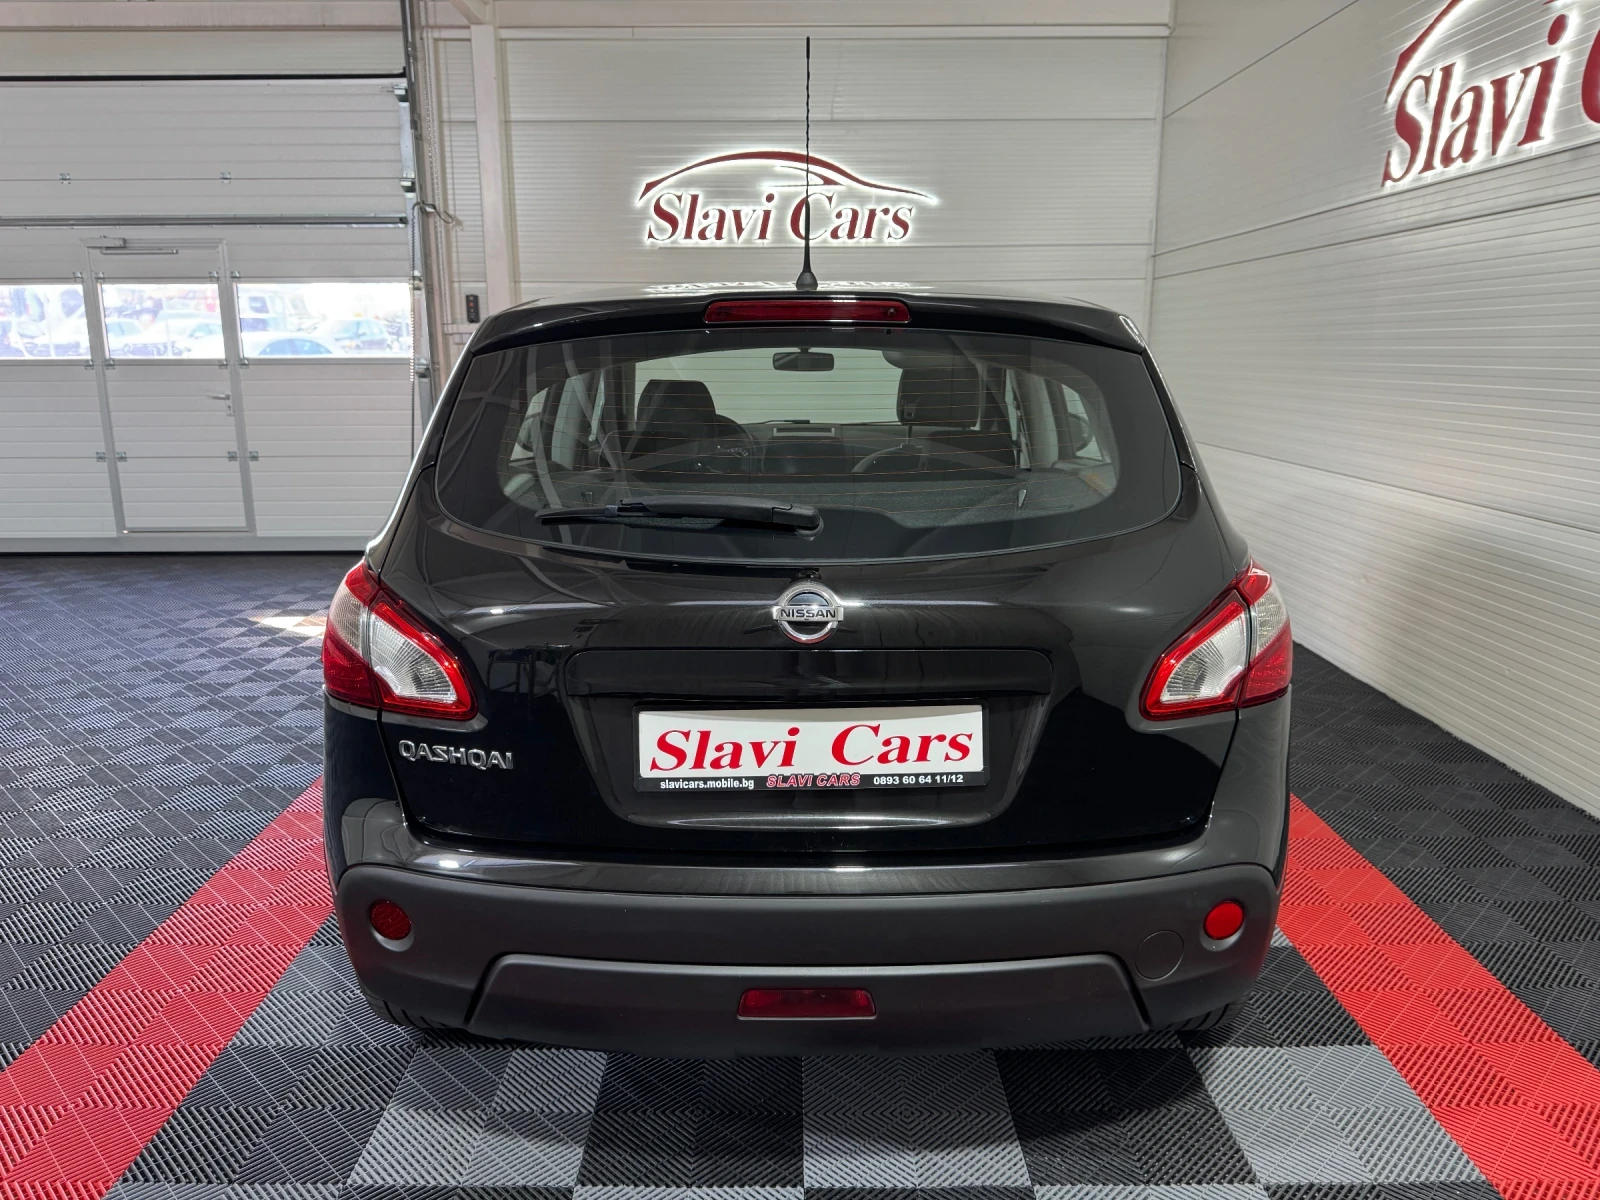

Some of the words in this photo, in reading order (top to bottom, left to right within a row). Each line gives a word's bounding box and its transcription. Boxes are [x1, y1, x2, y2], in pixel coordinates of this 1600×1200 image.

[1381, 13, 1570, 188] Slavi
[647, 192, 776, 241] Slavi
[789, 192, 914, 241] Cars
[780, 608, 836, 618] NISSAN
[398, 739, 514, 771] QASHQAI
[650, 726, 801, 772] Slavi
[831, 723, 974, 766] Cars
[660, 777, 755, 790] slavicars.mobile.bg
[766, 774, 813, 788] SLAVI
[816, 773, 861, 787] CARS
[873, 775, 900, 785] 0893
[902, 775, 916, 784] 60
[918, 774, 932, 784] 64
[935, 773, 964, 783] 11/12
